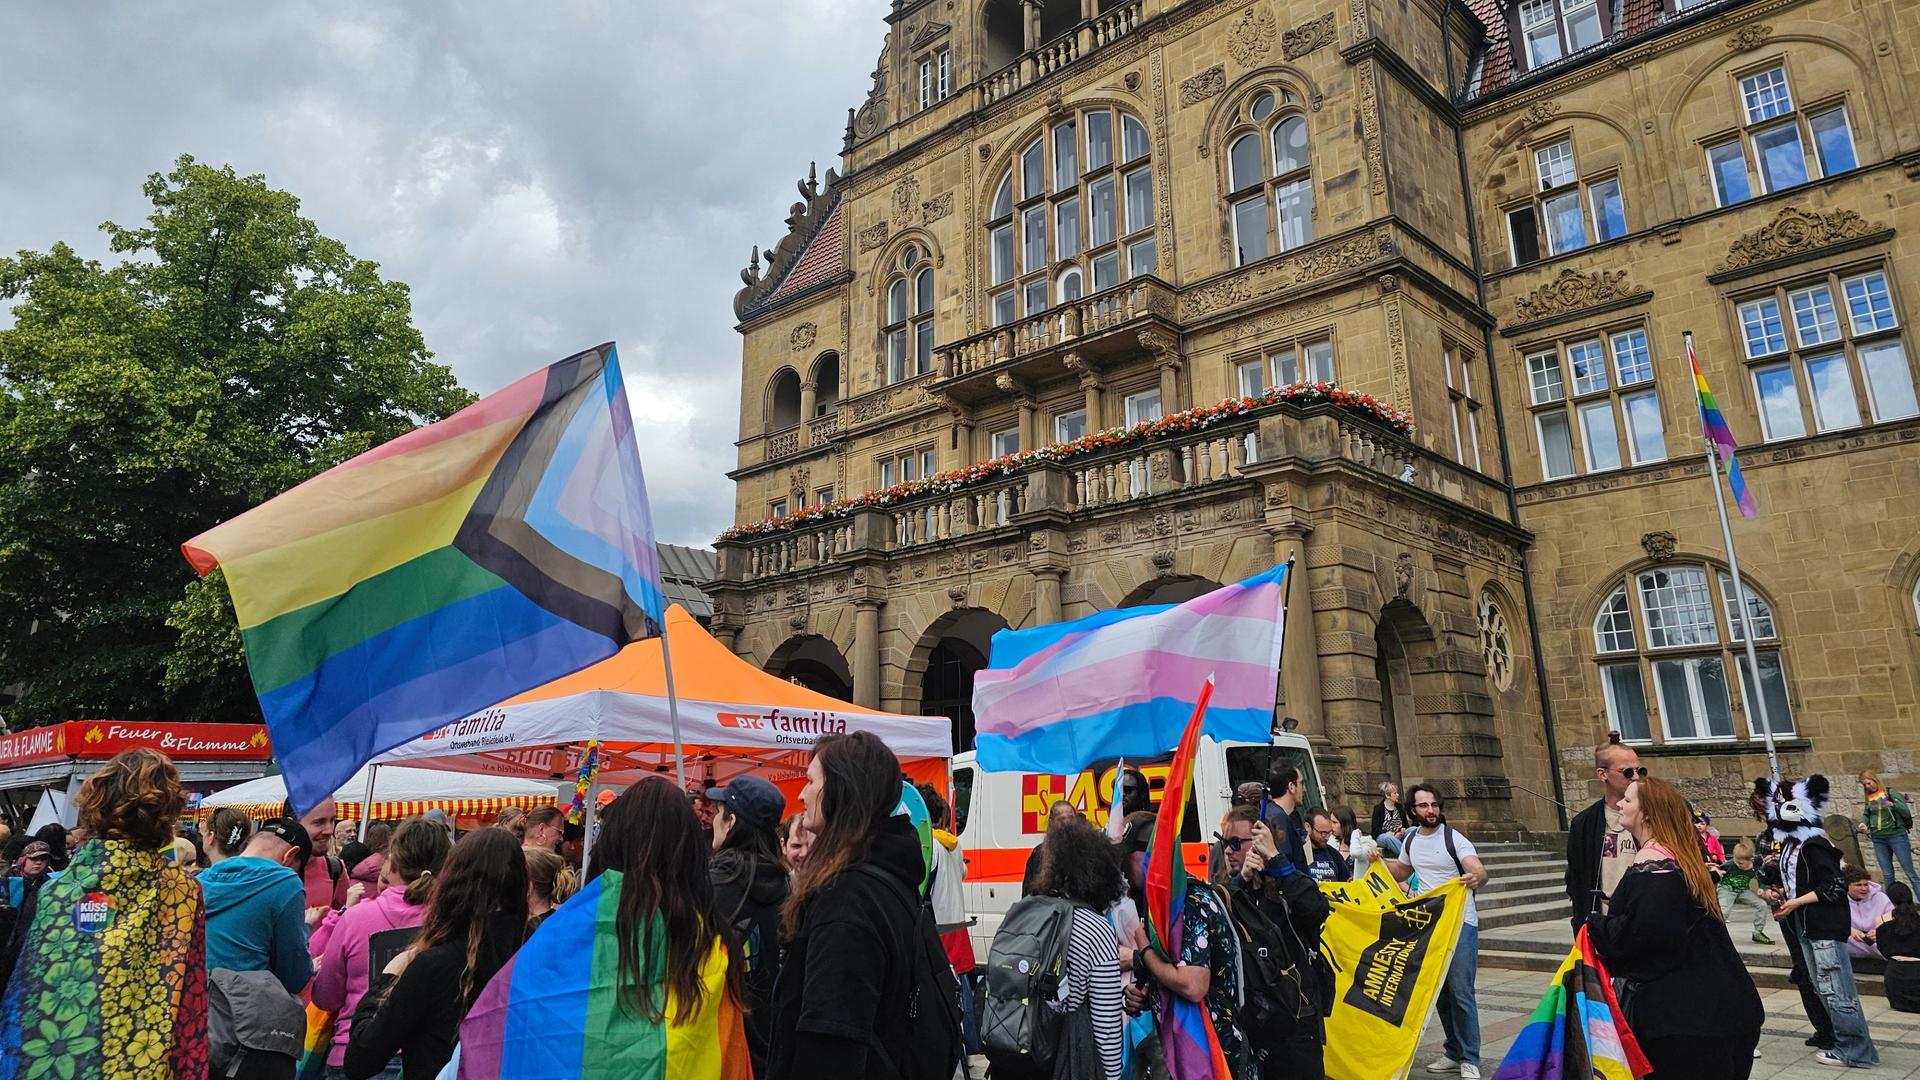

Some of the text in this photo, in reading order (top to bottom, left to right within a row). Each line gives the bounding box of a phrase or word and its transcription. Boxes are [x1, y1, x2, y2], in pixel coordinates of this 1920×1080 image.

[763, 708, 847, 734] familia
[21, 730, 54, 757] FLAMME
[107, 725, 162, 740] Feuer
[176, 737, 251, 751] Flamme
[450, 738, 481, 750] Ortsverband
[80, 901, 108, 912] KÜSS
[80, 912, 107, 923] MICH
[1363, 937, 1406, 1001] AMNESTY
[1380, 939, 1419, 1008] INTERNATIONAL
